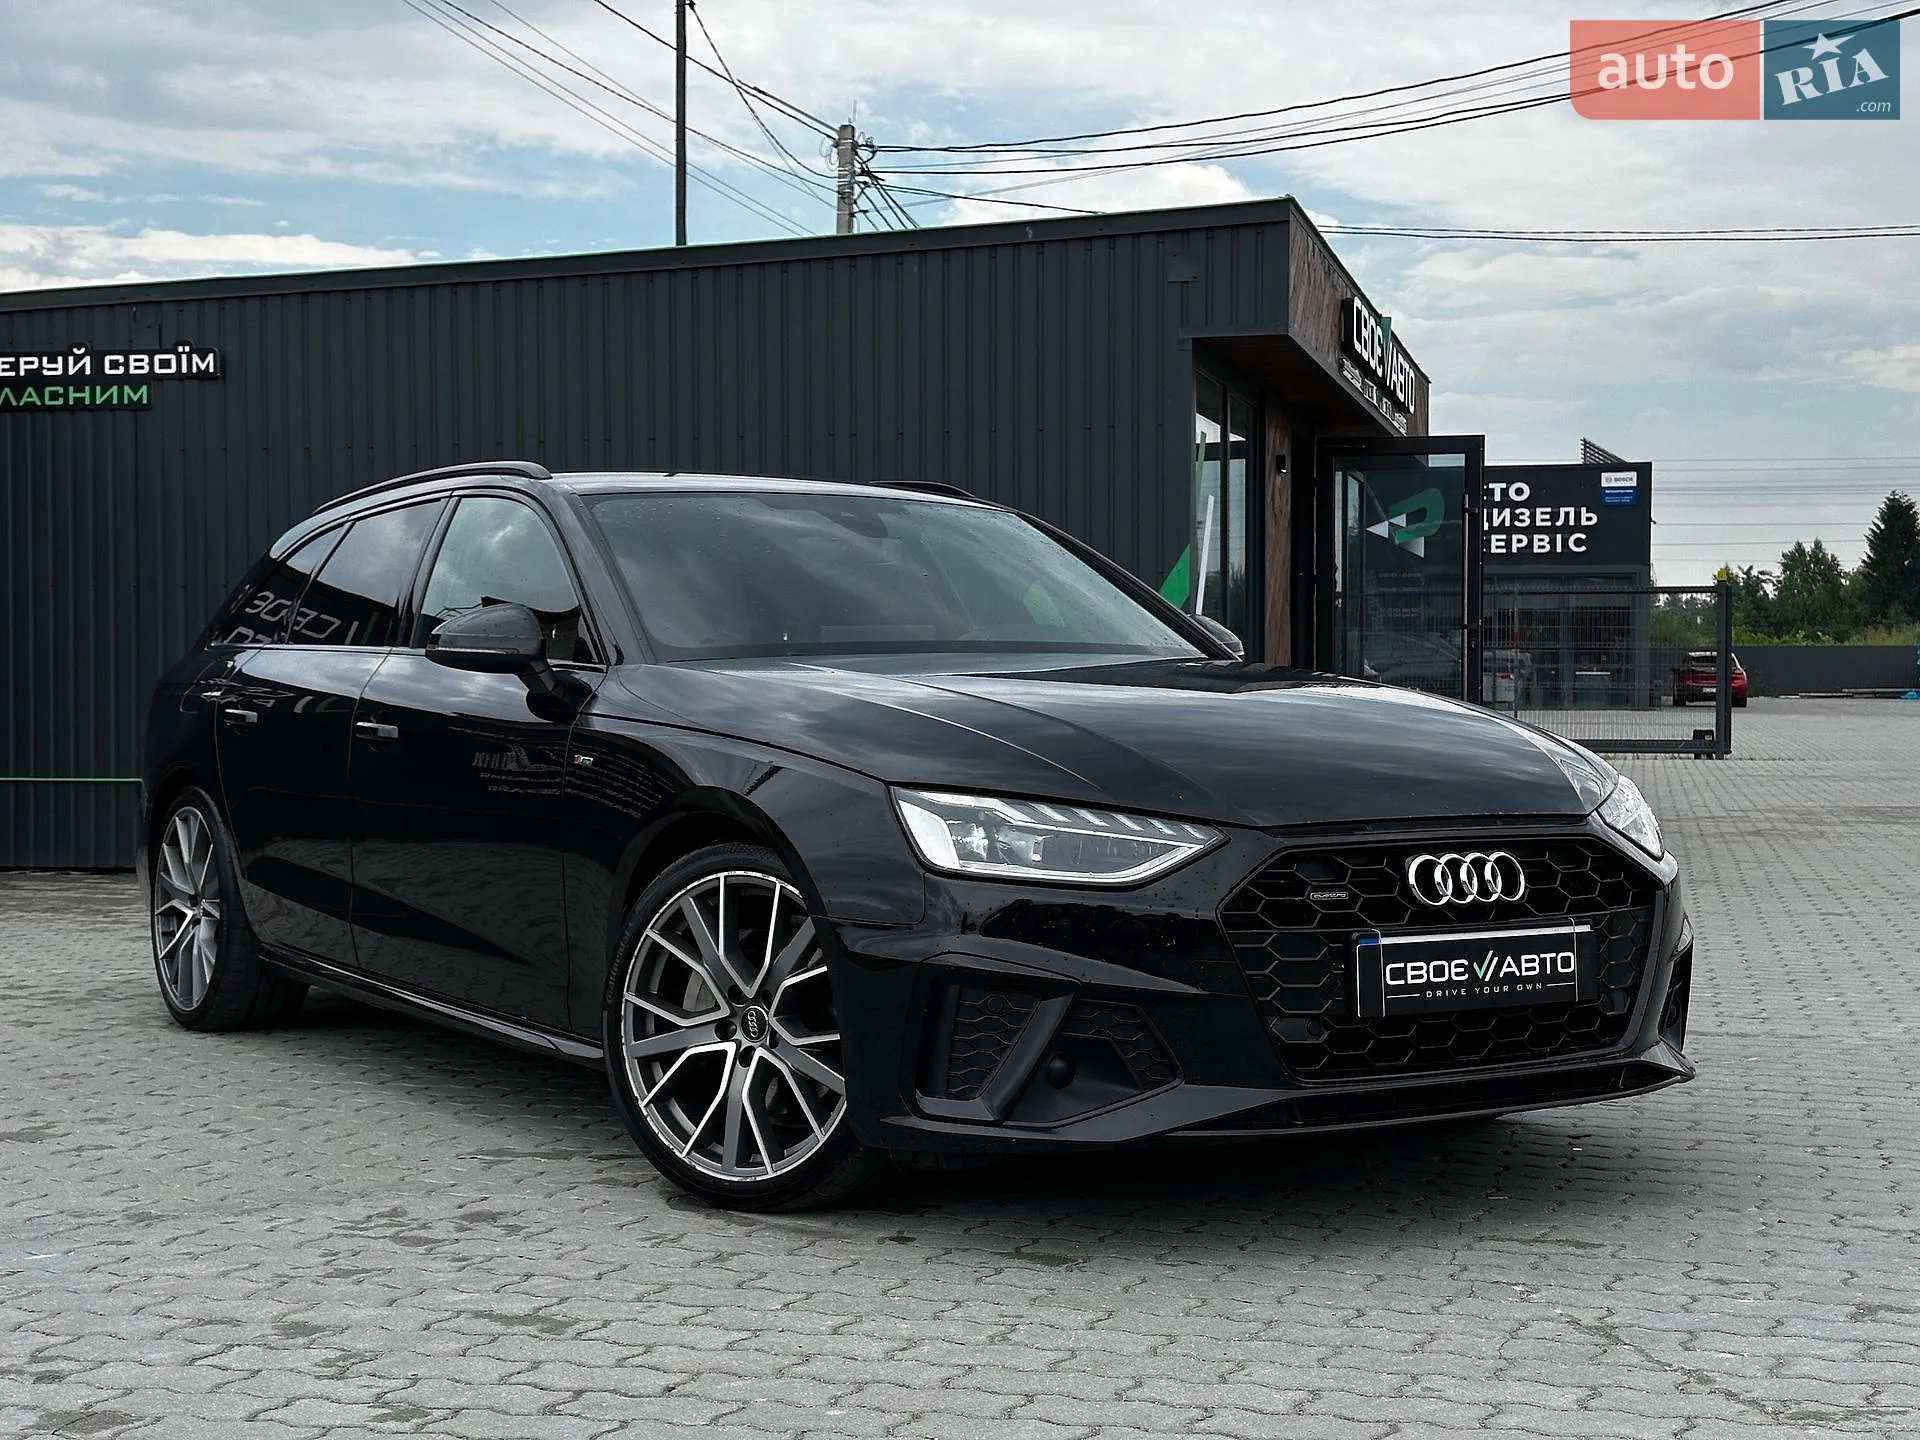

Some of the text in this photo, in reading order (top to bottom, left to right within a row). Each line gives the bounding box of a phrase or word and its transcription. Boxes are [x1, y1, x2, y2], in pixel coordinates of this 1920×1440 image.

[104, 346, 215, 375] СВОЇМ
[1483, 482, 1530, 502] ТО
[1483, 533, 1588, 554] ЕРВІС
[1499, 951, 1575, 978] АВТО
[1426, 982, 1542, 998] DRIVE YOUR OWN
